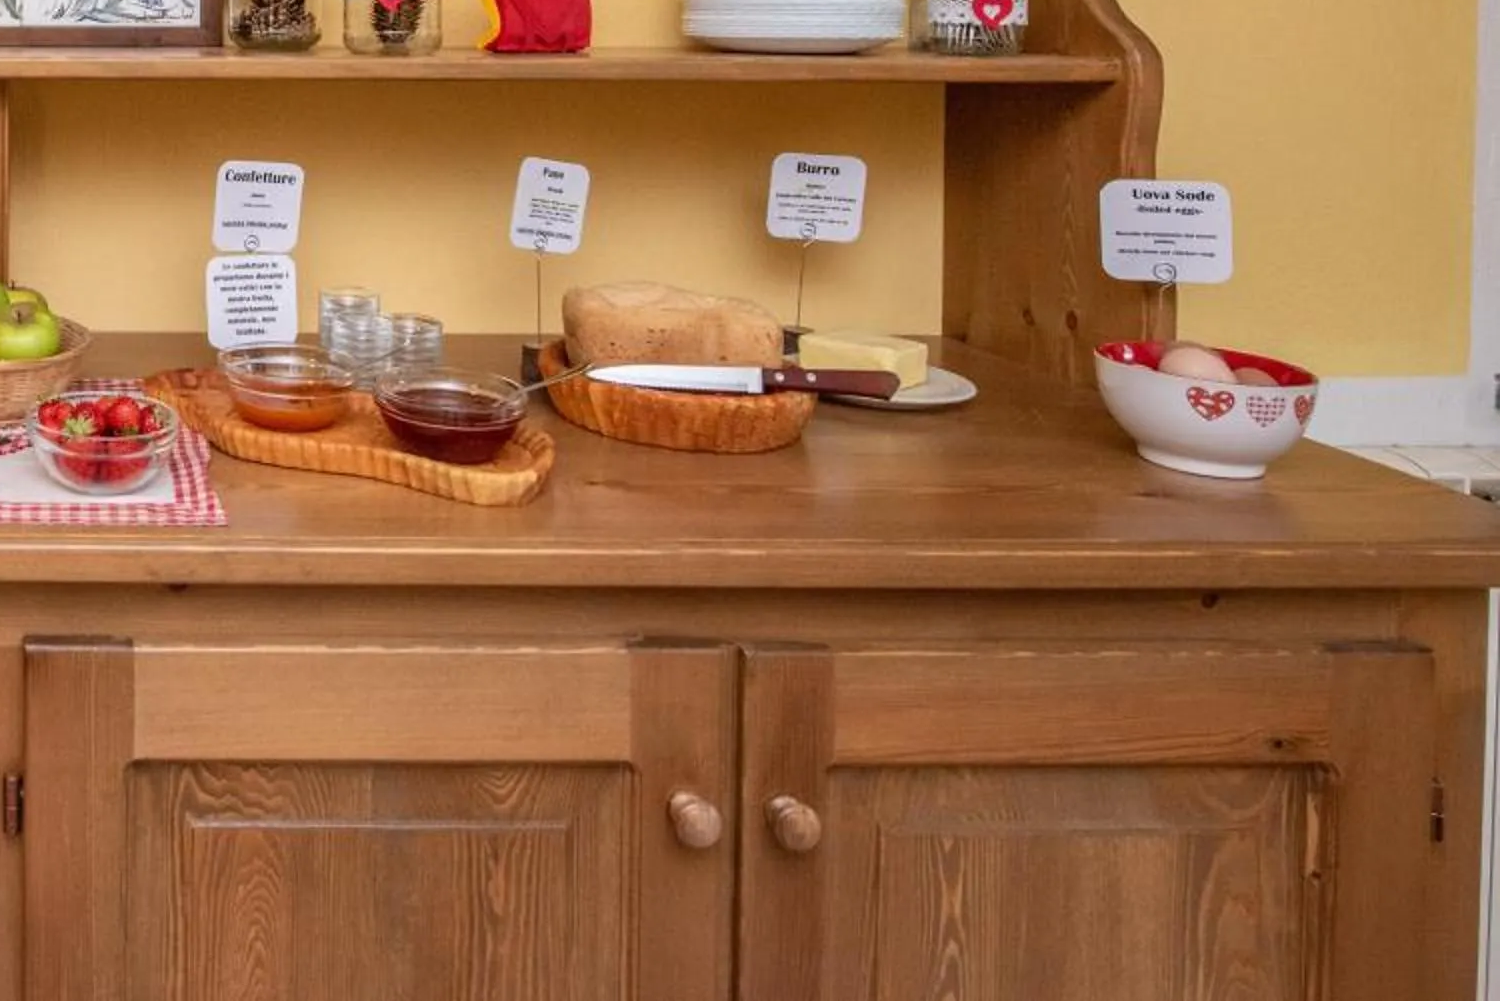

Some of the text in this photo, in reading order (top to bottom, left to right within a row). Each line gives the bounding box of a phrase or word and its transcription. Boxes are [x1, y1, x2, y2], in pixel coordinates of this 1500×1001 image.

[796, 160, 841, 176] Burro
[224, 168, 298, 186] Confetture
[1132, 187, 1216, 202] Uova Sode
